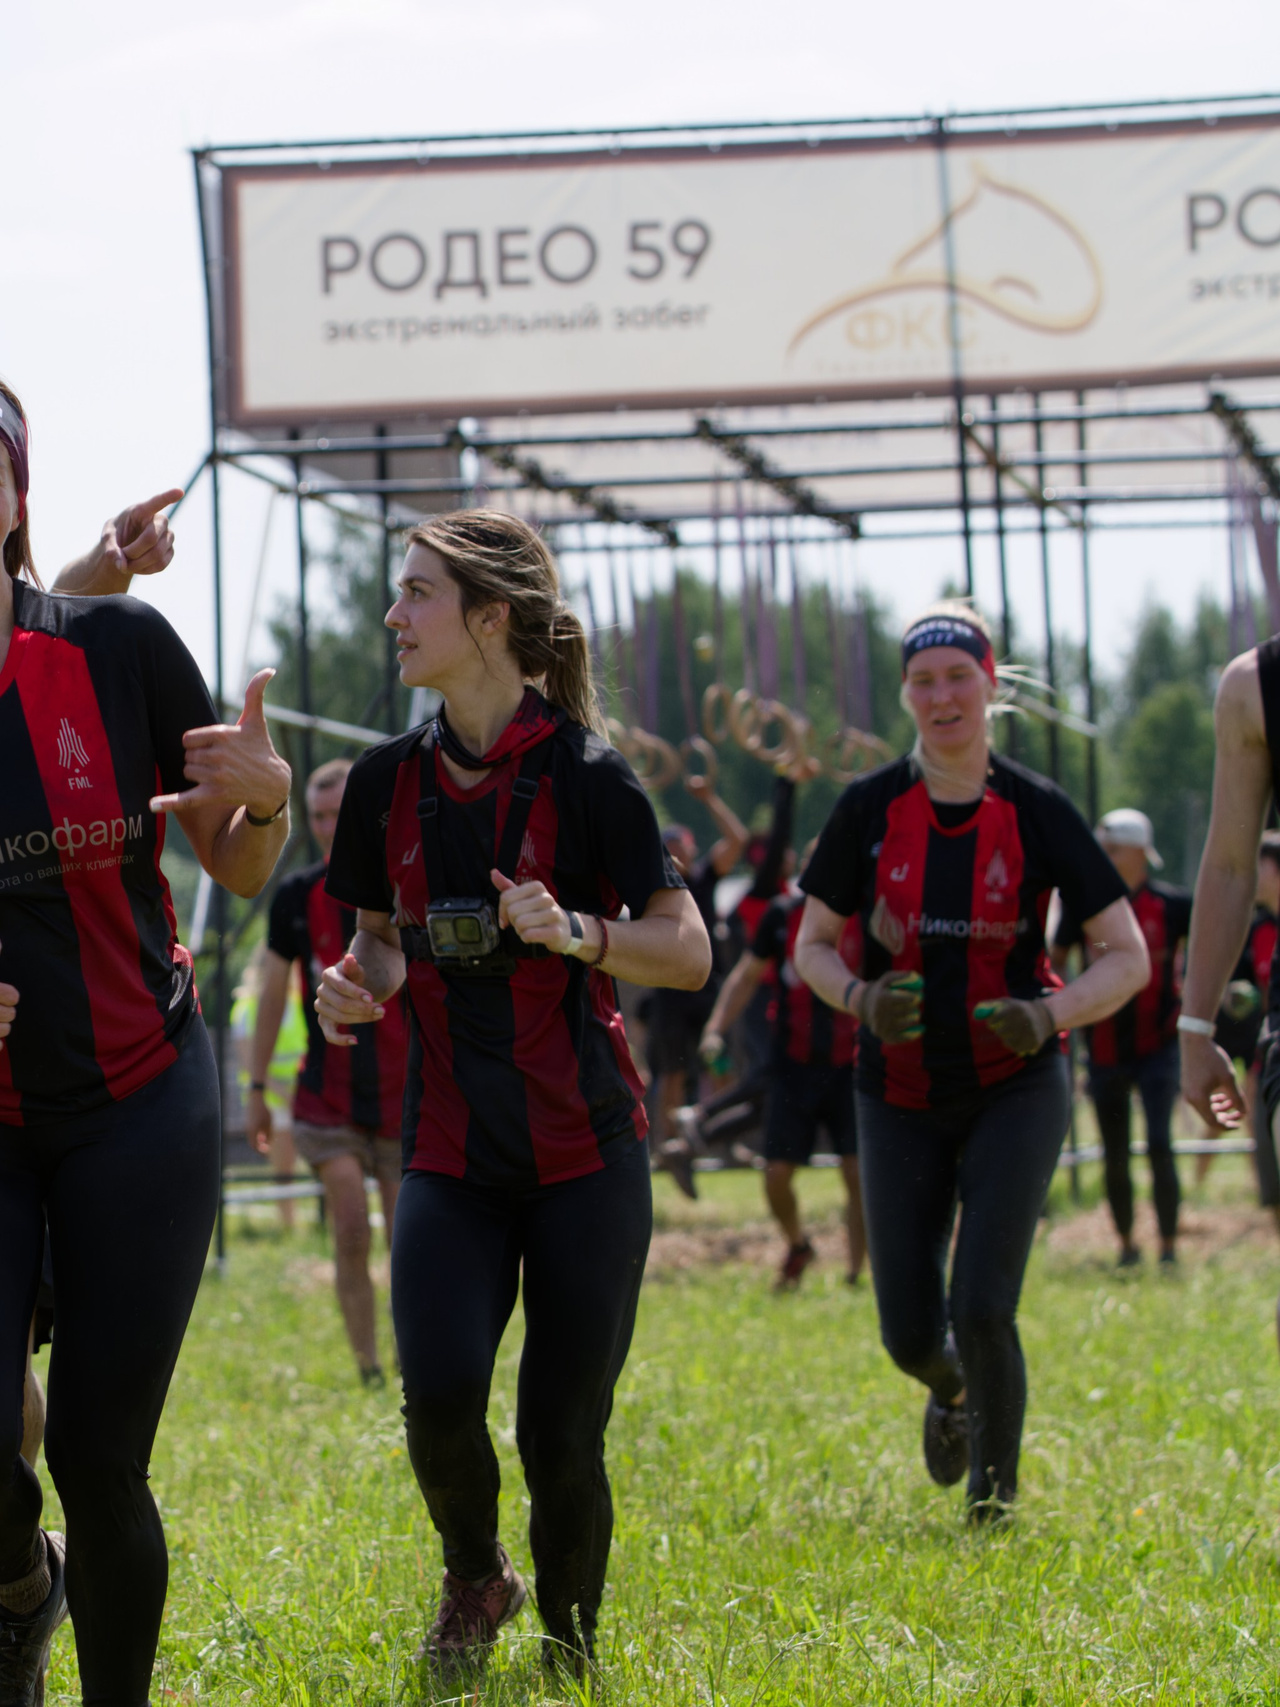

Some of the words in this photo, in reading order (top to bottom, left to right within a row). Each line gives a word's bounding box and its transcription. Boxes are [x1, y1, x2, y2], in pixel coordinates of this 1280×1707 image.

[321, 222, 599, 300] РОДЕО
[626, 218, 712, 282] 59
[323, 302, 602, 345] экстремальный
[613, 298, 711, 329] забег
[67, 775, 94, 791] FML
[24, 871, 35, 883] о
[37, 860, 83, 880] ваших
[86, 853, 136, 872] клиентах
